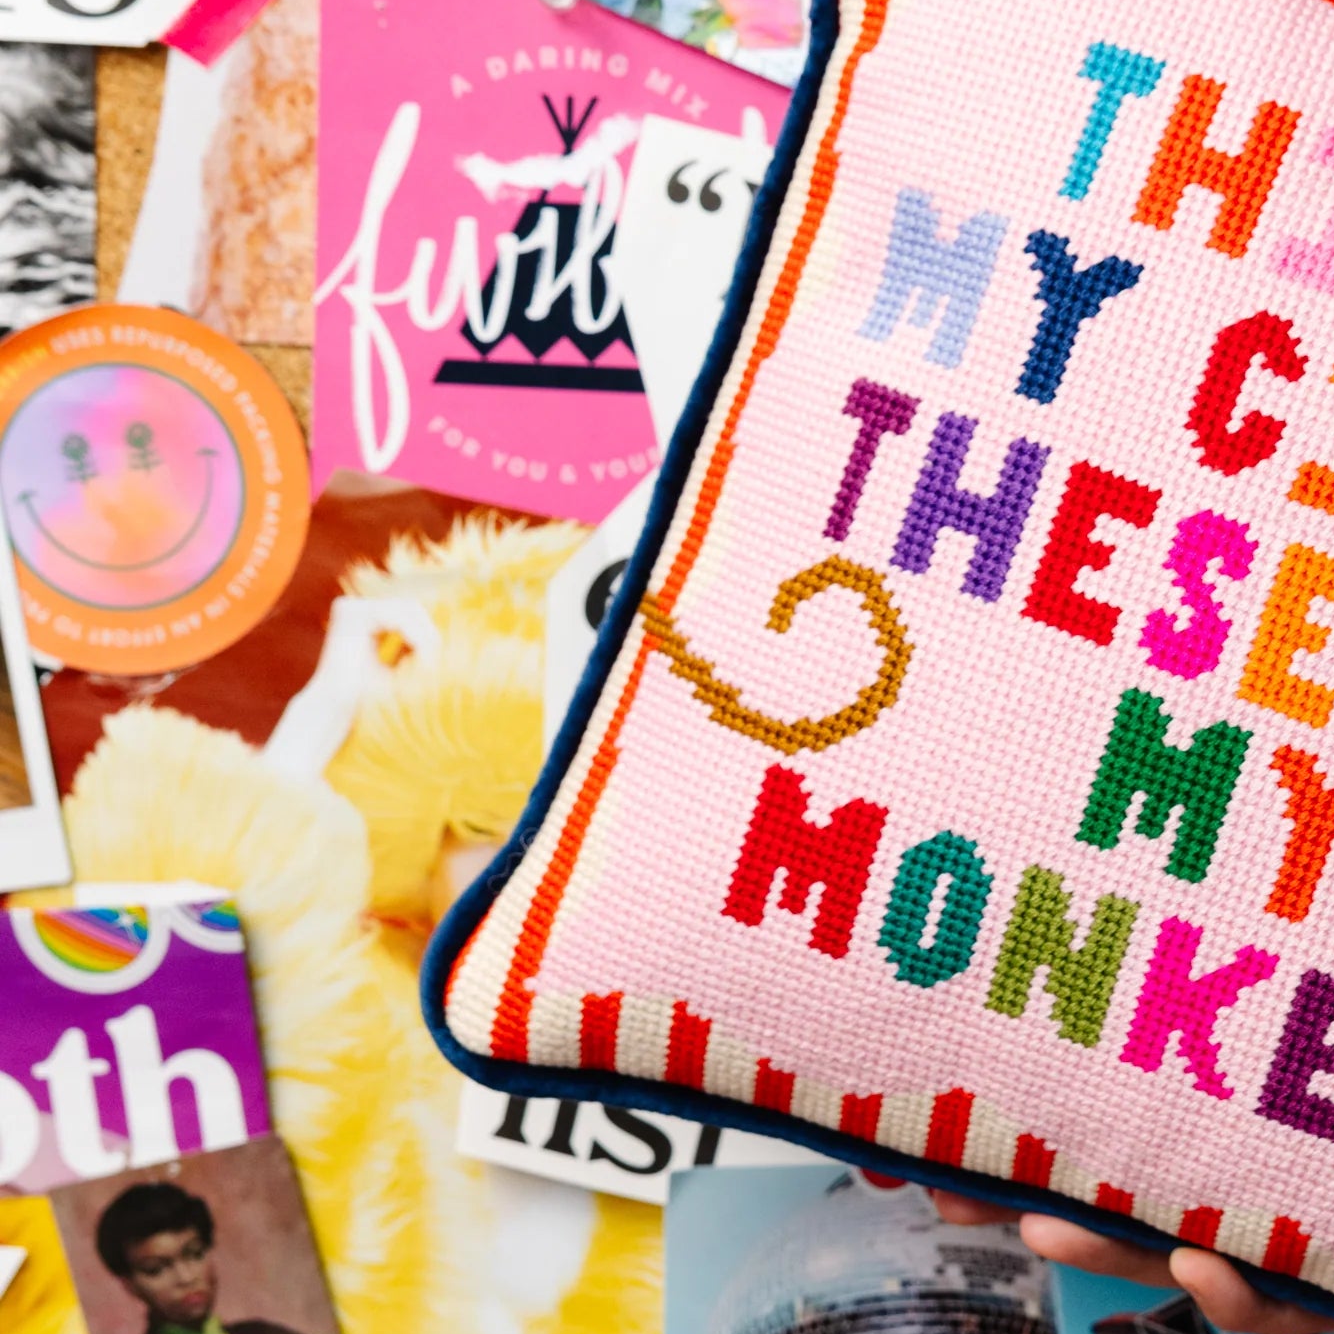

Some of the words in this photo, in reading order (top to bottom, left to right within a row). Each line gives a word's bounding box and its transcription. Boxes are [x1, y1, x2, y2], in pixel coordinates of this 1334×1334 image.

[451, 74, 473, 99] A
[486, 46, 629, 80] DARING
[645, 67, 709, 120] MIX
[856, 187, 1144, 404] MY
[427, 415, 483, 459] FOR
[491, 449, 549, 483] YOU
[558, 463, 579, 485] &
